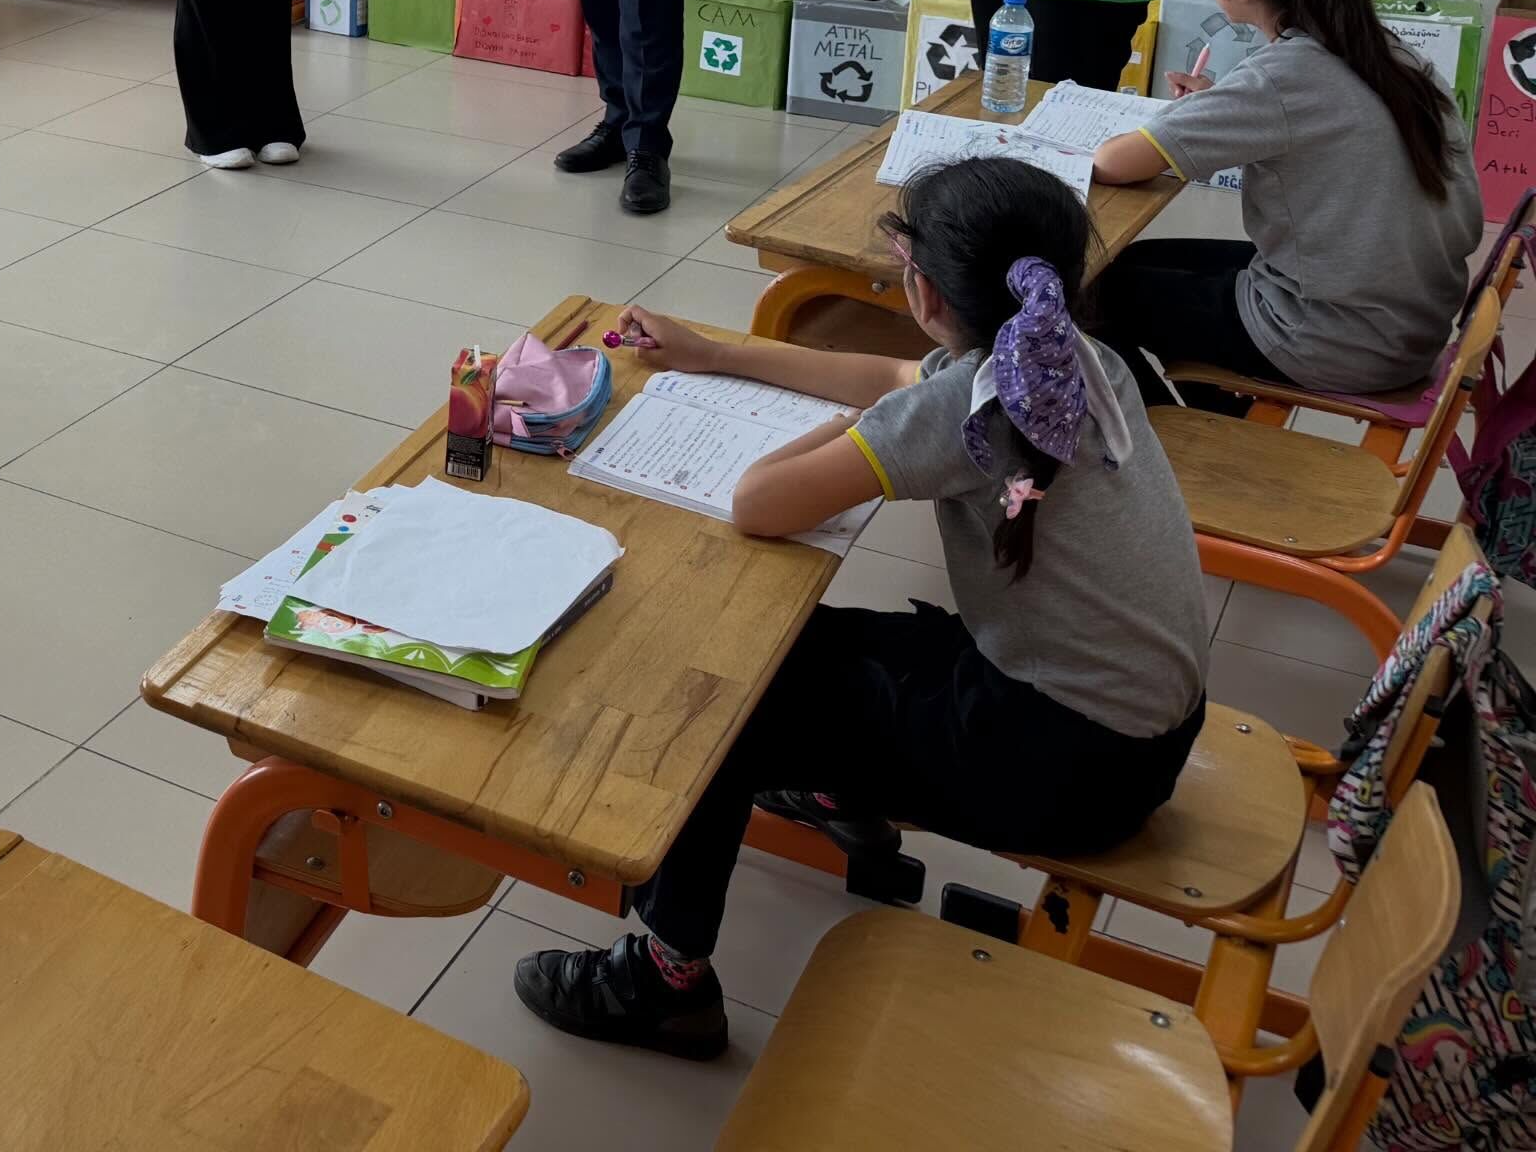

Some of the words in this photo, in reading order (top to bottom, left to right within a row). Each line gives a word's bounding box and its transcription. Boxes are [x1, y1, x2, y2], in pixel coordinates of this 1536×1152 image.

[698, 3, 756, 28] CAM
[825, 25, 872, 43] ATIK
[814, 40, 883, 60] METAL
[1487, 120, 1520, 138] geri
[1483, 160, 1528, 176] Atık
